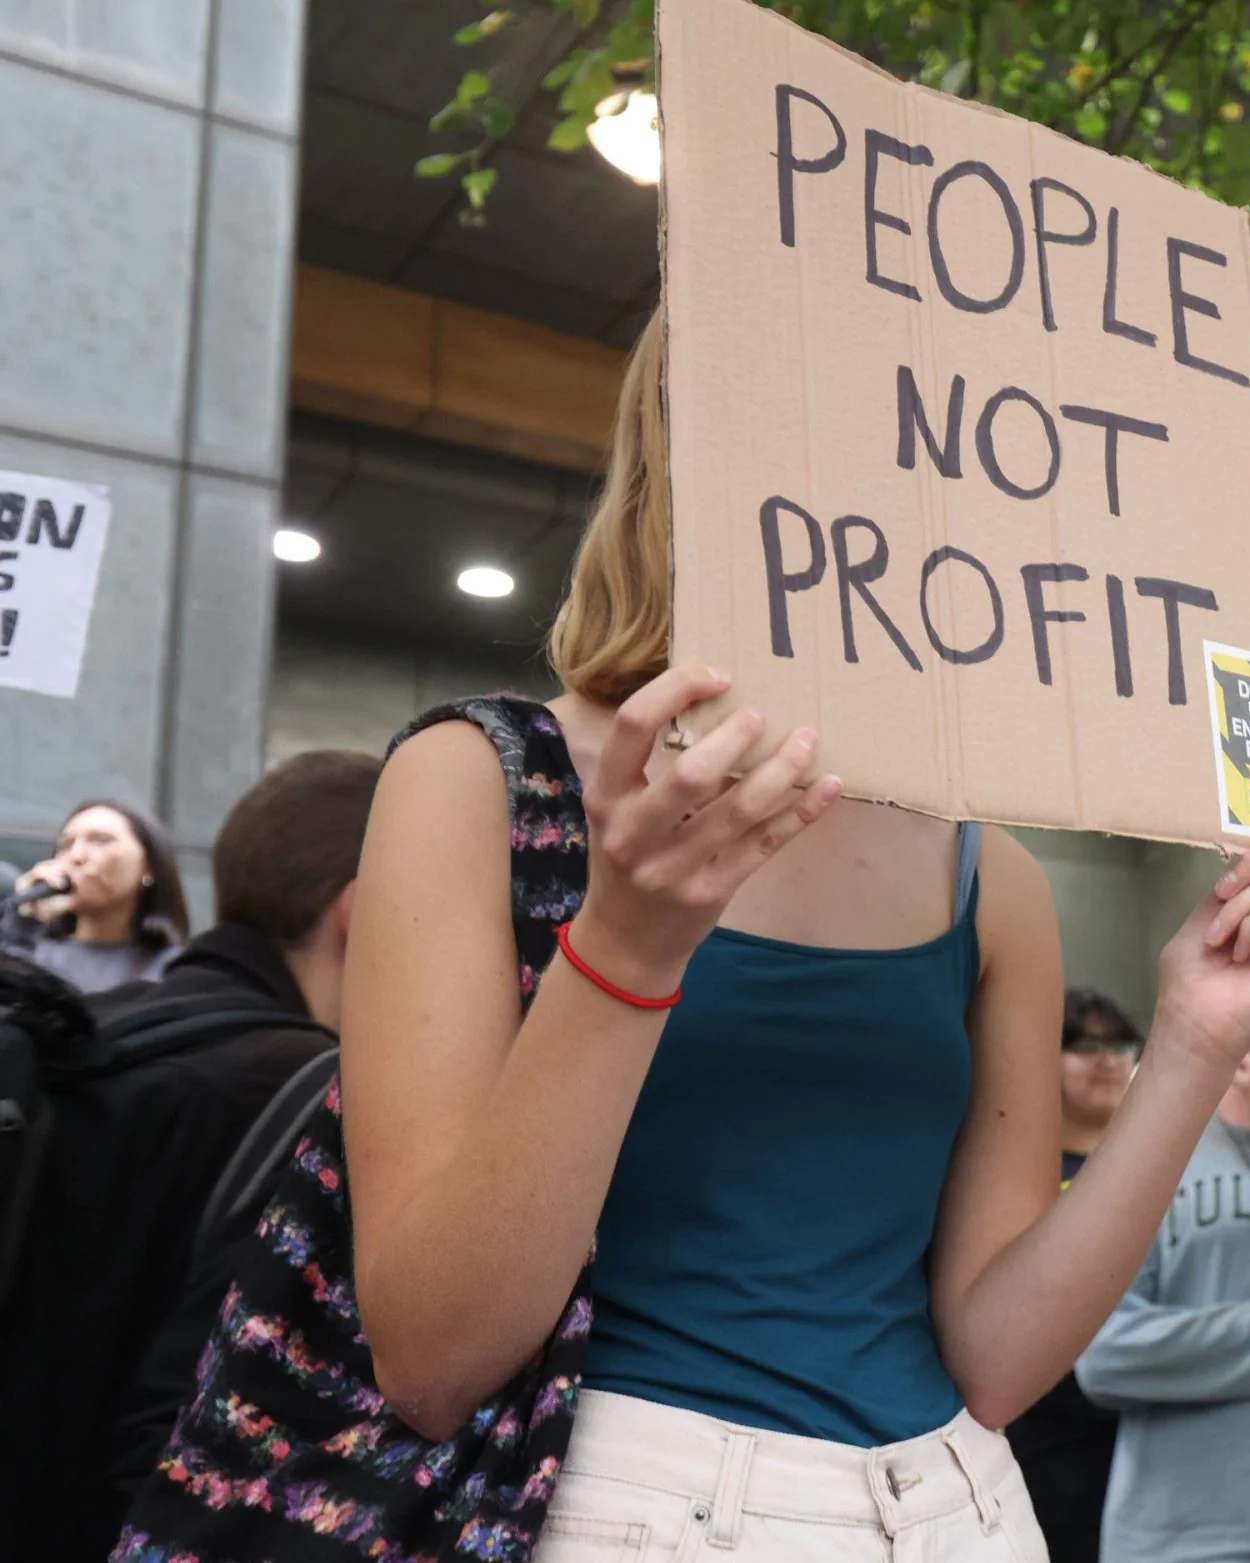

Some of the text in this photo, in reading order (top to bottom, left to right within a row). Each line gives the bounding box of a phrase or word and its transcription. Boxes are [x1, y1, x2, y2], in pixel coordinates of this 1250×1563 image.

[769, 84, 1250, 389] PEOPLE
[896, 364, 1171, 518] NOT
[759, 495, 1220, 706] PROFIT
